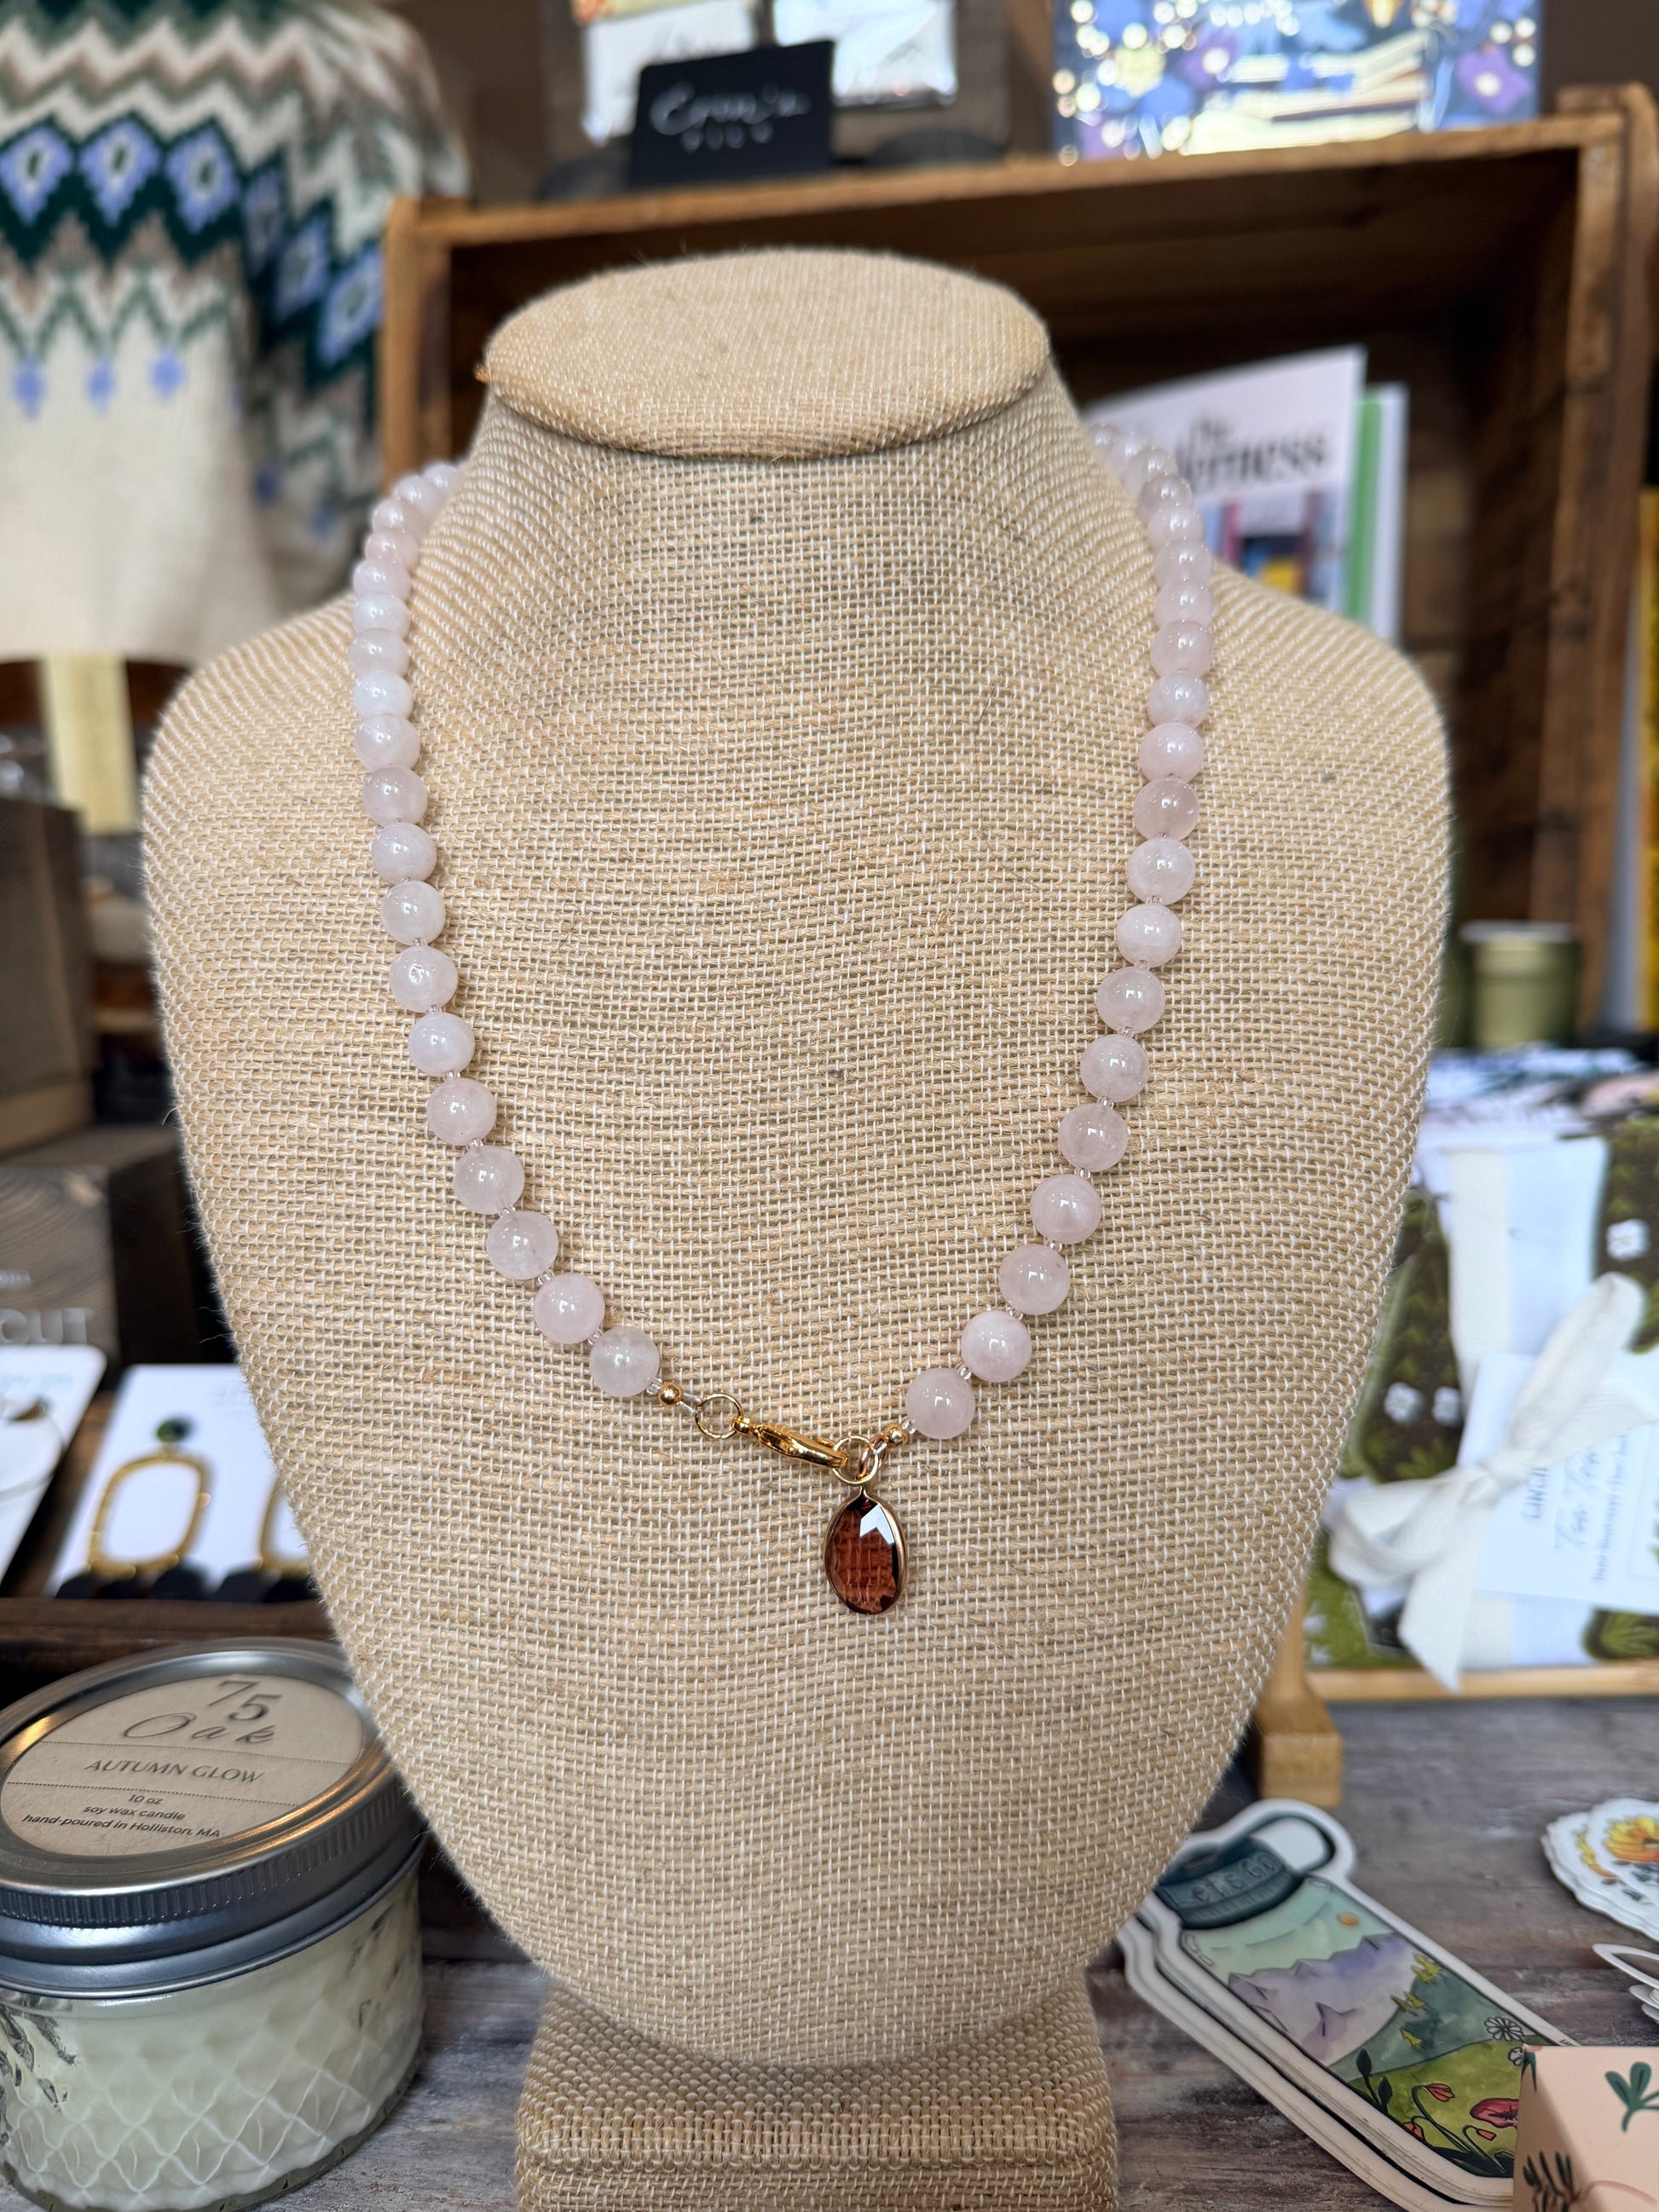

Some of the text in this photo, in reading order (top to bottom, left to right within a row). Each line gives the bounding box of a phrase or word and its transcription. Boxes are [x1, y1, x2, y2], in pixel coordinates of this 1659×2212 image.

[206, 1679, 282, 1721] 75
[122, 1712, 277, 1744] Oak
[84, 1759, 265, 1783] AUTUMN GLOW
[128, 1793, 164, 1805] 10 oz
[83, 1805, 187, 1821] soy wax candle
[22, 1813, 221, 1838] hand-poured in Holliston, MA
